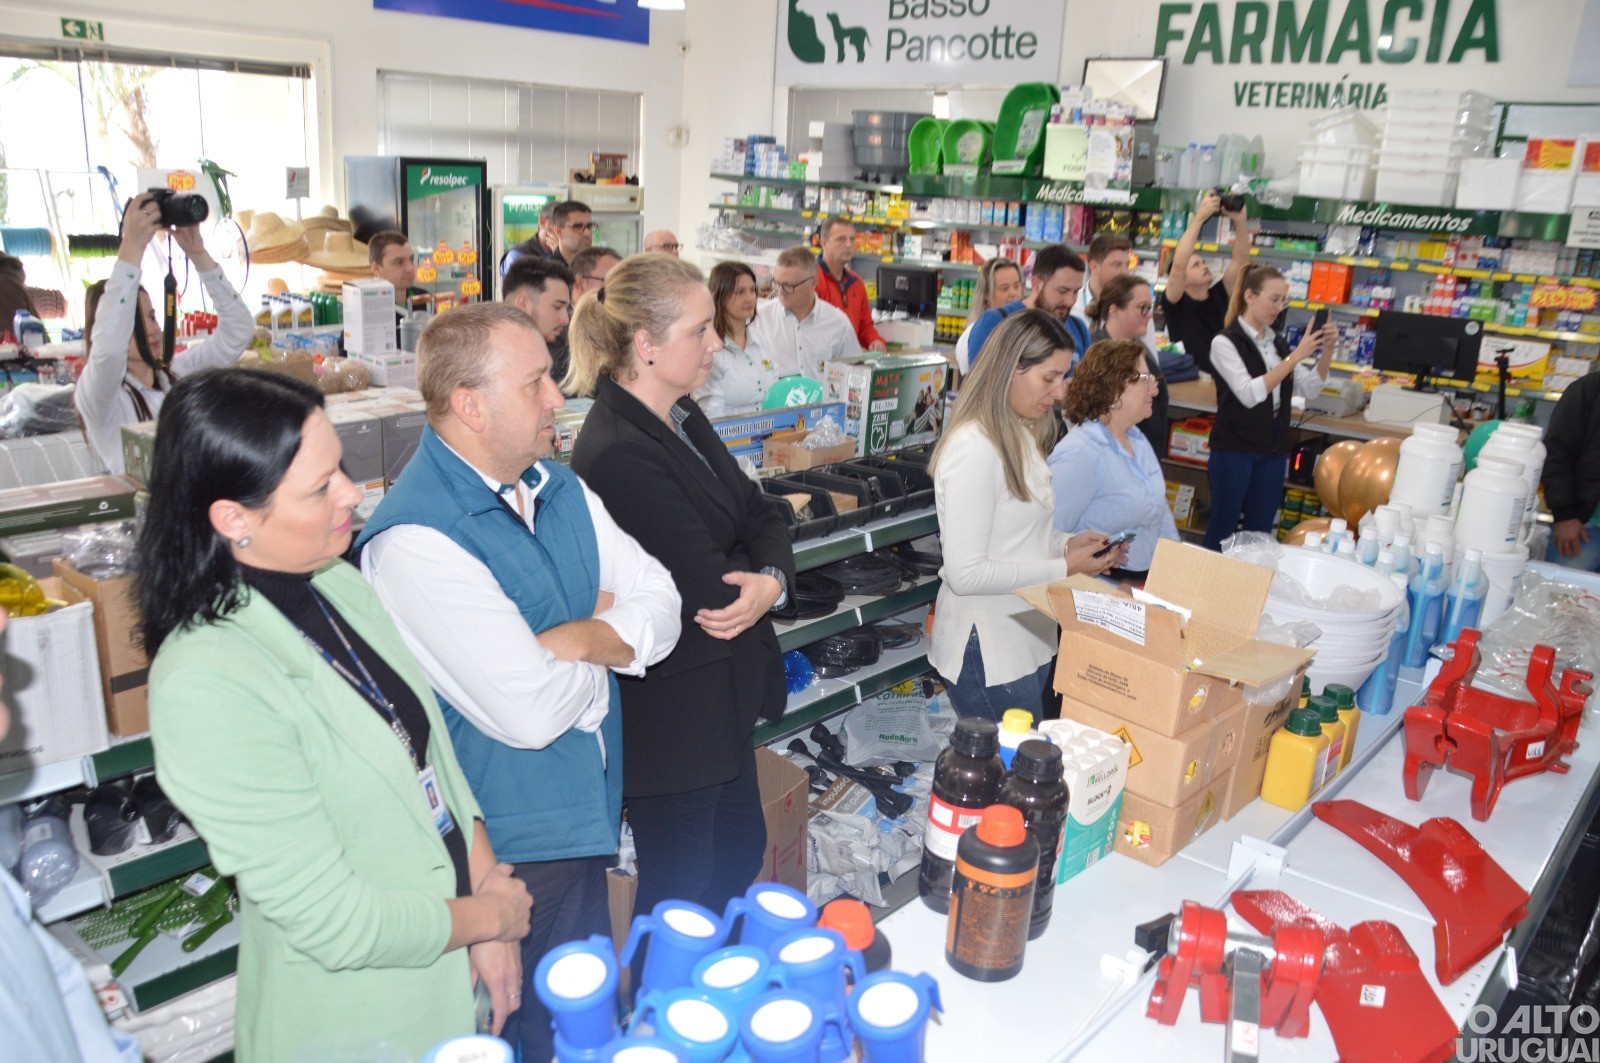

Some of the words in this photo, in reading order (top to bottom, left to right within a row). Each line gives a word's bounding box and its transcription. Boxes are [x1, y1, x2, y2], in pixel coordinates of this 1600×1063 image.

[888, 0, 991, 20] Basso
[886, 28, 1038, 63] Pancotte
[1234, 74, 1388, 109] VETERINÁRIA
[430, 173, 467, 187] resolpec
[1336, 205, 1473, 232] Medicamentos
[878, 733, 918, 744] RedeAgro
